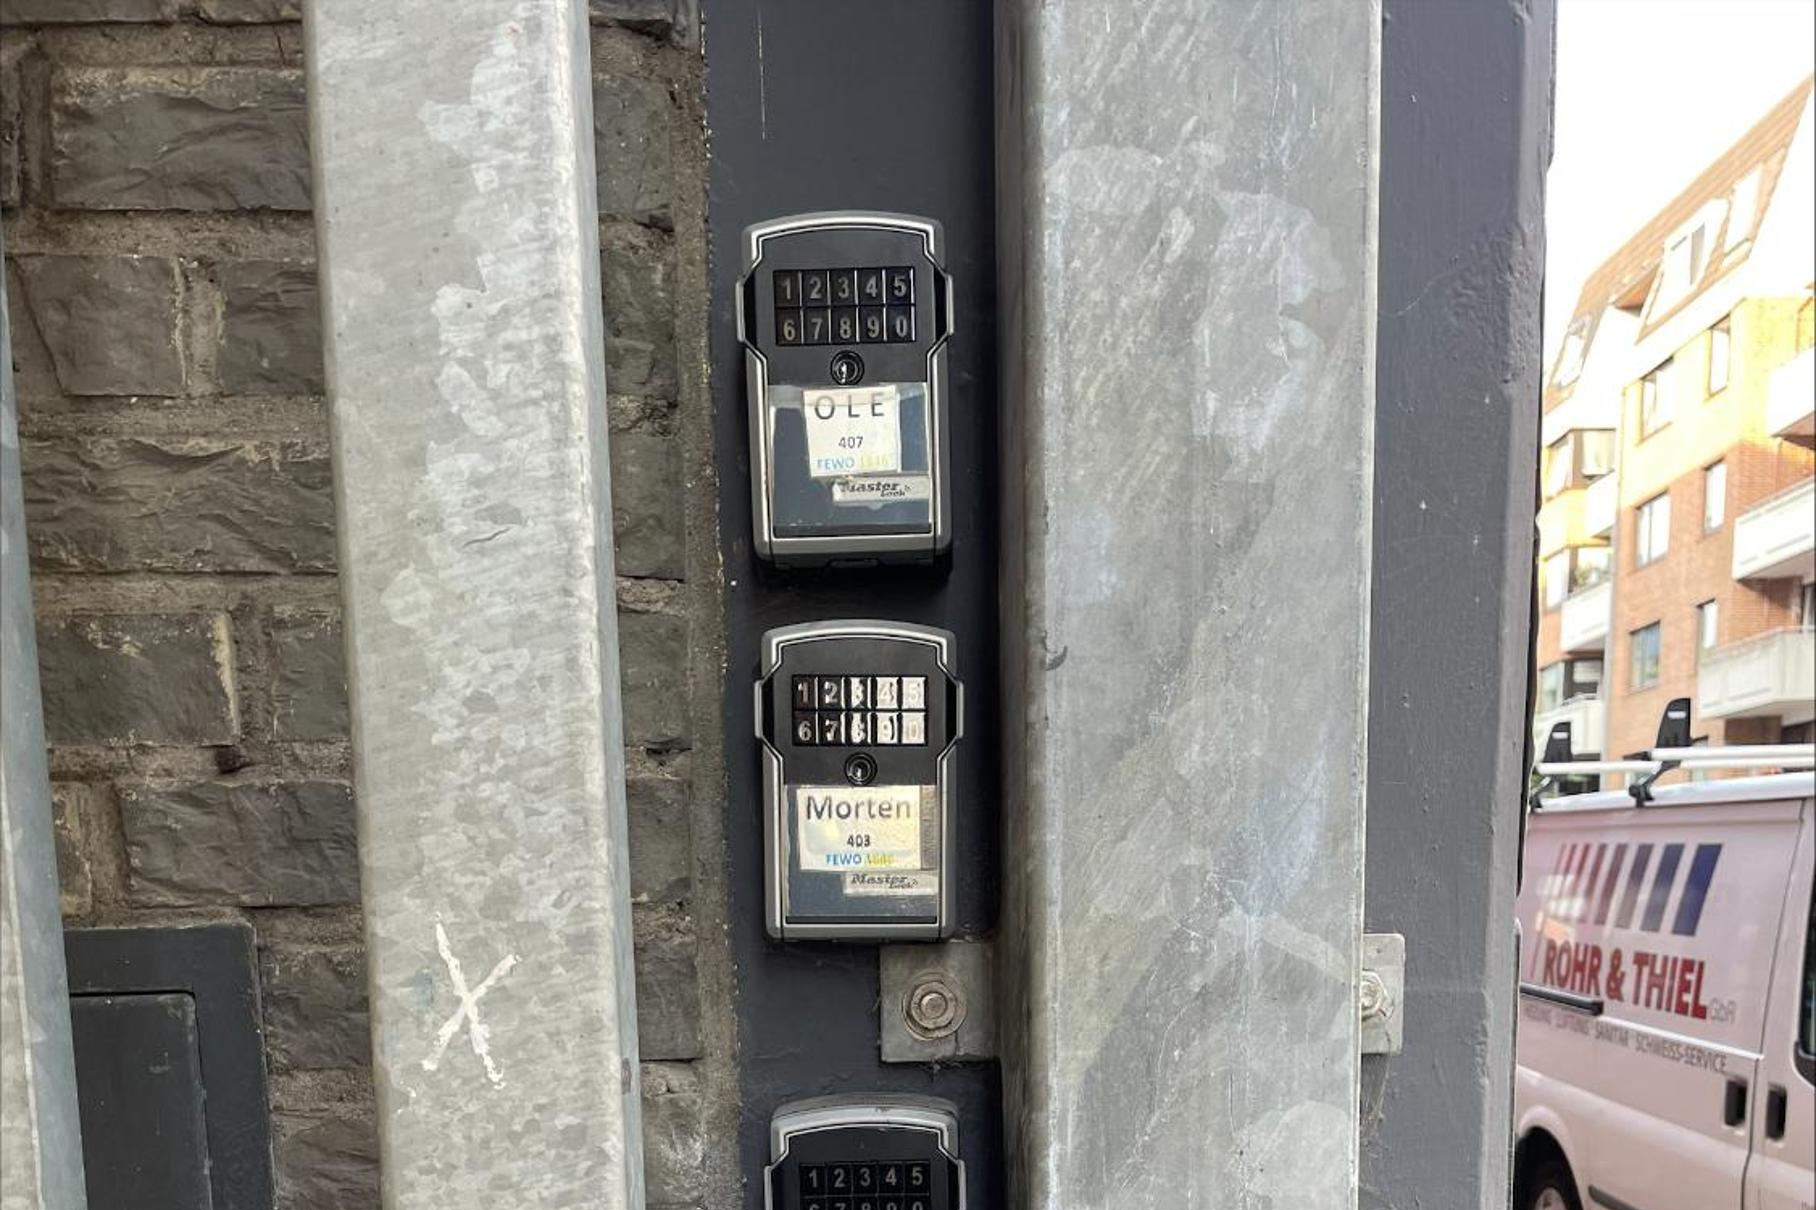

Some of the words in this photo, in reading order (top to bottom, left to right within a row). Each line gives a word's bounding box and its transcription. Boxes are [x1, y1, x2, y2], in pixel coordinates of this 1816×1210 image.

[781, 277, 792, 300] 1
[809, 276, 822, 299] 2
[837, 276, 850, 299] 3
[865, 275, 878, 298] 4
[893, 274, 907, 297] 5
[783, 319, 796, 341] 6
[811, 317, 824, 340] 7
[839, 316, 852, 339] 8
[867, 315, 880, 338] 9
[895, 314, 908, 338] 0
[814, 392, 885, 420] OLE
[838, 436, 864, 449] 407
[798, 681, 809, 703] 1
[824, 681, 838, 704] 2
[798, 720, 812, 741] 6
[824, 718, 839, 741] 7
[806, 795, 912, 820] Morten
[847, 834, 871, 847] 403
[851, 873, 907, 885] Master
[1542, 938, 1603, 997] ROHR
[1605, 947, 1626, 1002] &
[1632, 951, 1708, 1021] THIEL
[808, 1167, 818, 1188] 1
[833, 1167, 846, 1188] 2
[859, 1167, 871, 1187] 3
[885, 1165, 898, 1186] 4
[911, 1166, 923, 1186] 5
